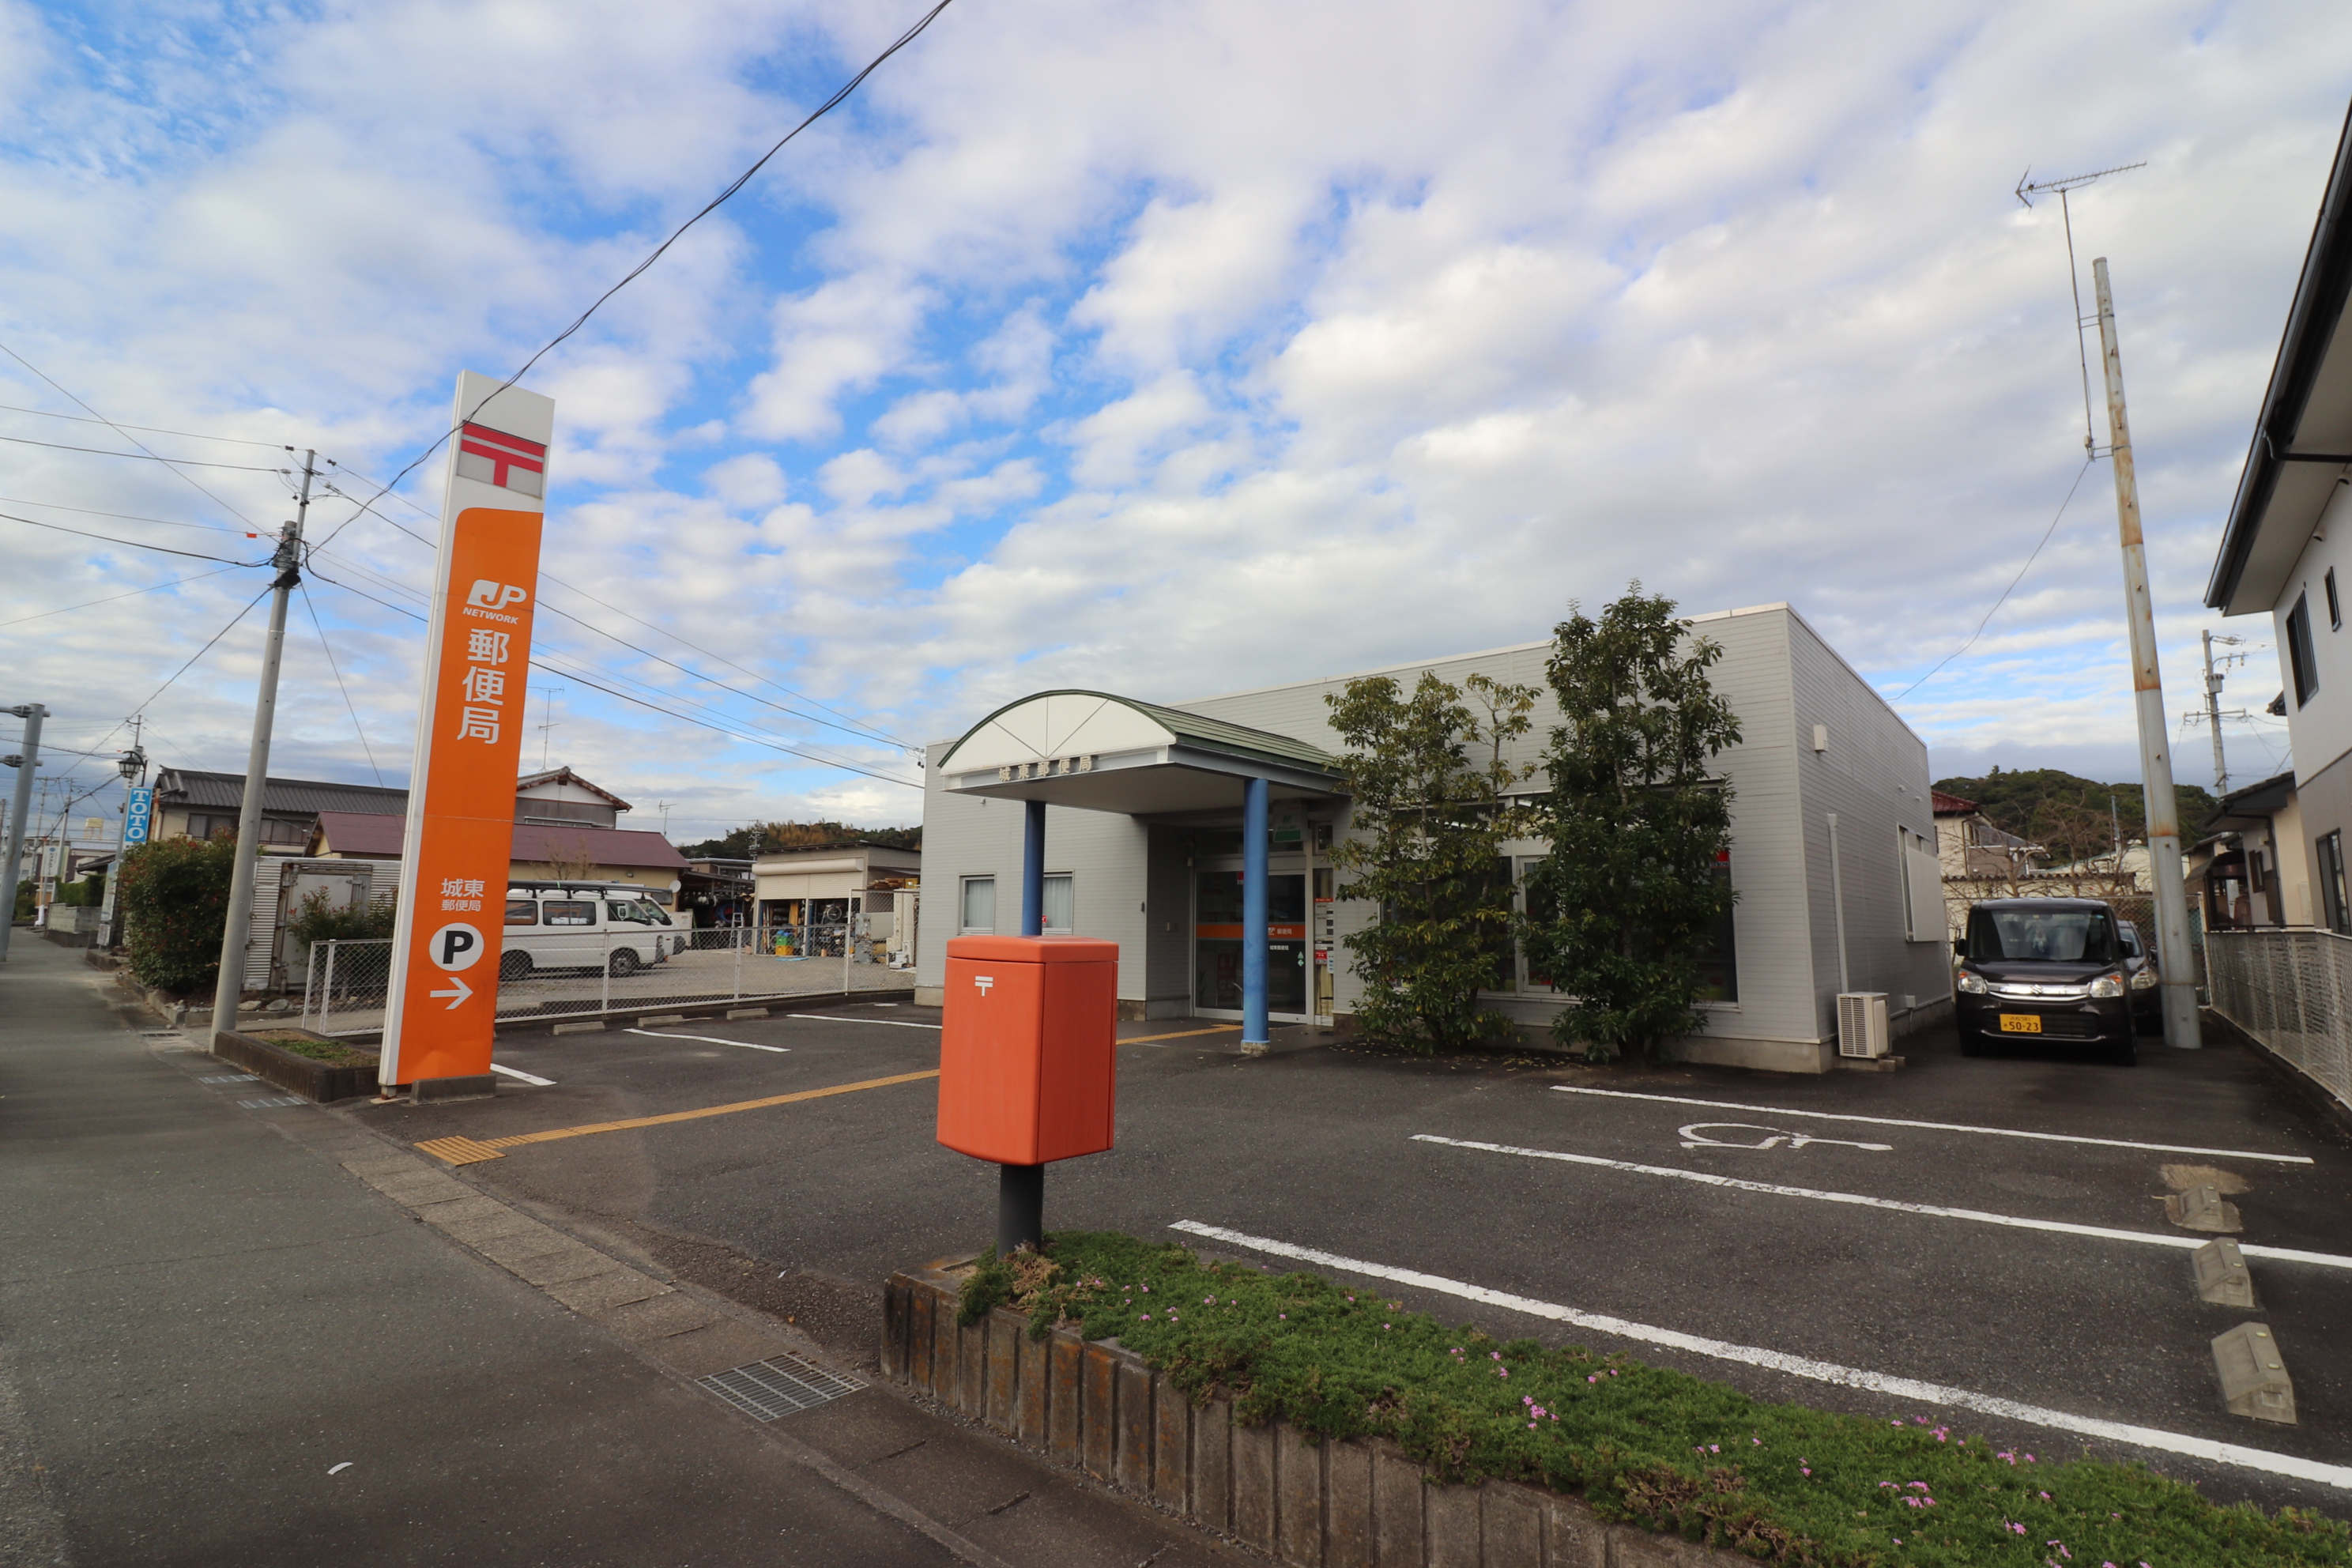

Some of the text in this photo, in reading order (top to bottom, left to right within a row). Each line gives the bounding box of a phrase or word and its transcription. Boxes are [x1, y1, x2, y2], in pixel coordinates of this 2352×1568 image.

[466, 579, 527, 610] JP
[462, 606, 519, 625] NETWORK
[457, 628, 511, 744] 郵便局
[998, 755, 1092, 782] 城東郵便局
[127, 790, 149, 839] TOTO
[440, 878, 485, 898] 城東
[441, 899, 481, 912] 郵便局
[443, 930, 474, 964] P
[2009, 1021, 2039, 1031] 50-23
